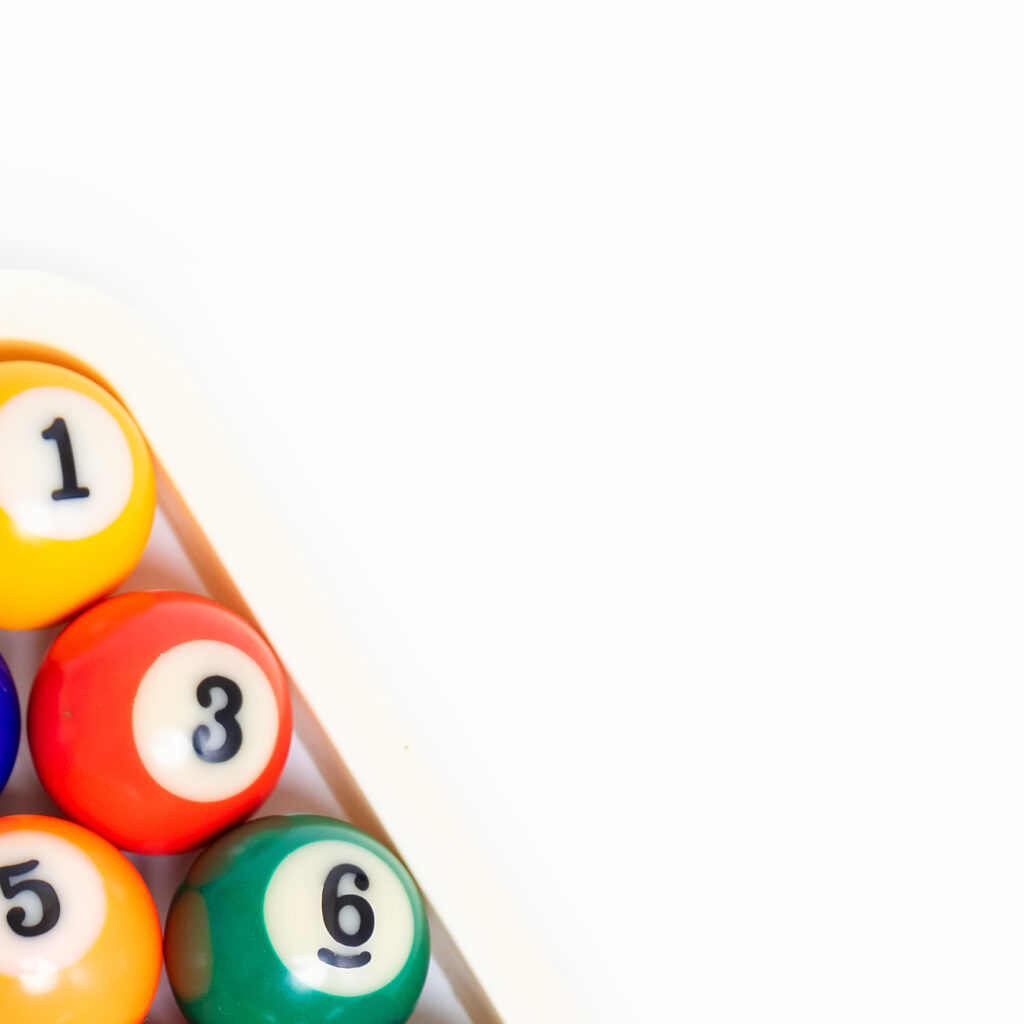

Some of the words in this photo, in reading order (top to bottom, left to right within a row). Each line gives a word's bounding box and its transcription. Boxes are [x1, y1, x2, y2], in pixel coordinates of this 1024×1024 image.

[41, 417, 90, 501] 1
[192, 675, 243, 763] 3
[320, 864, 375, 948] 6
